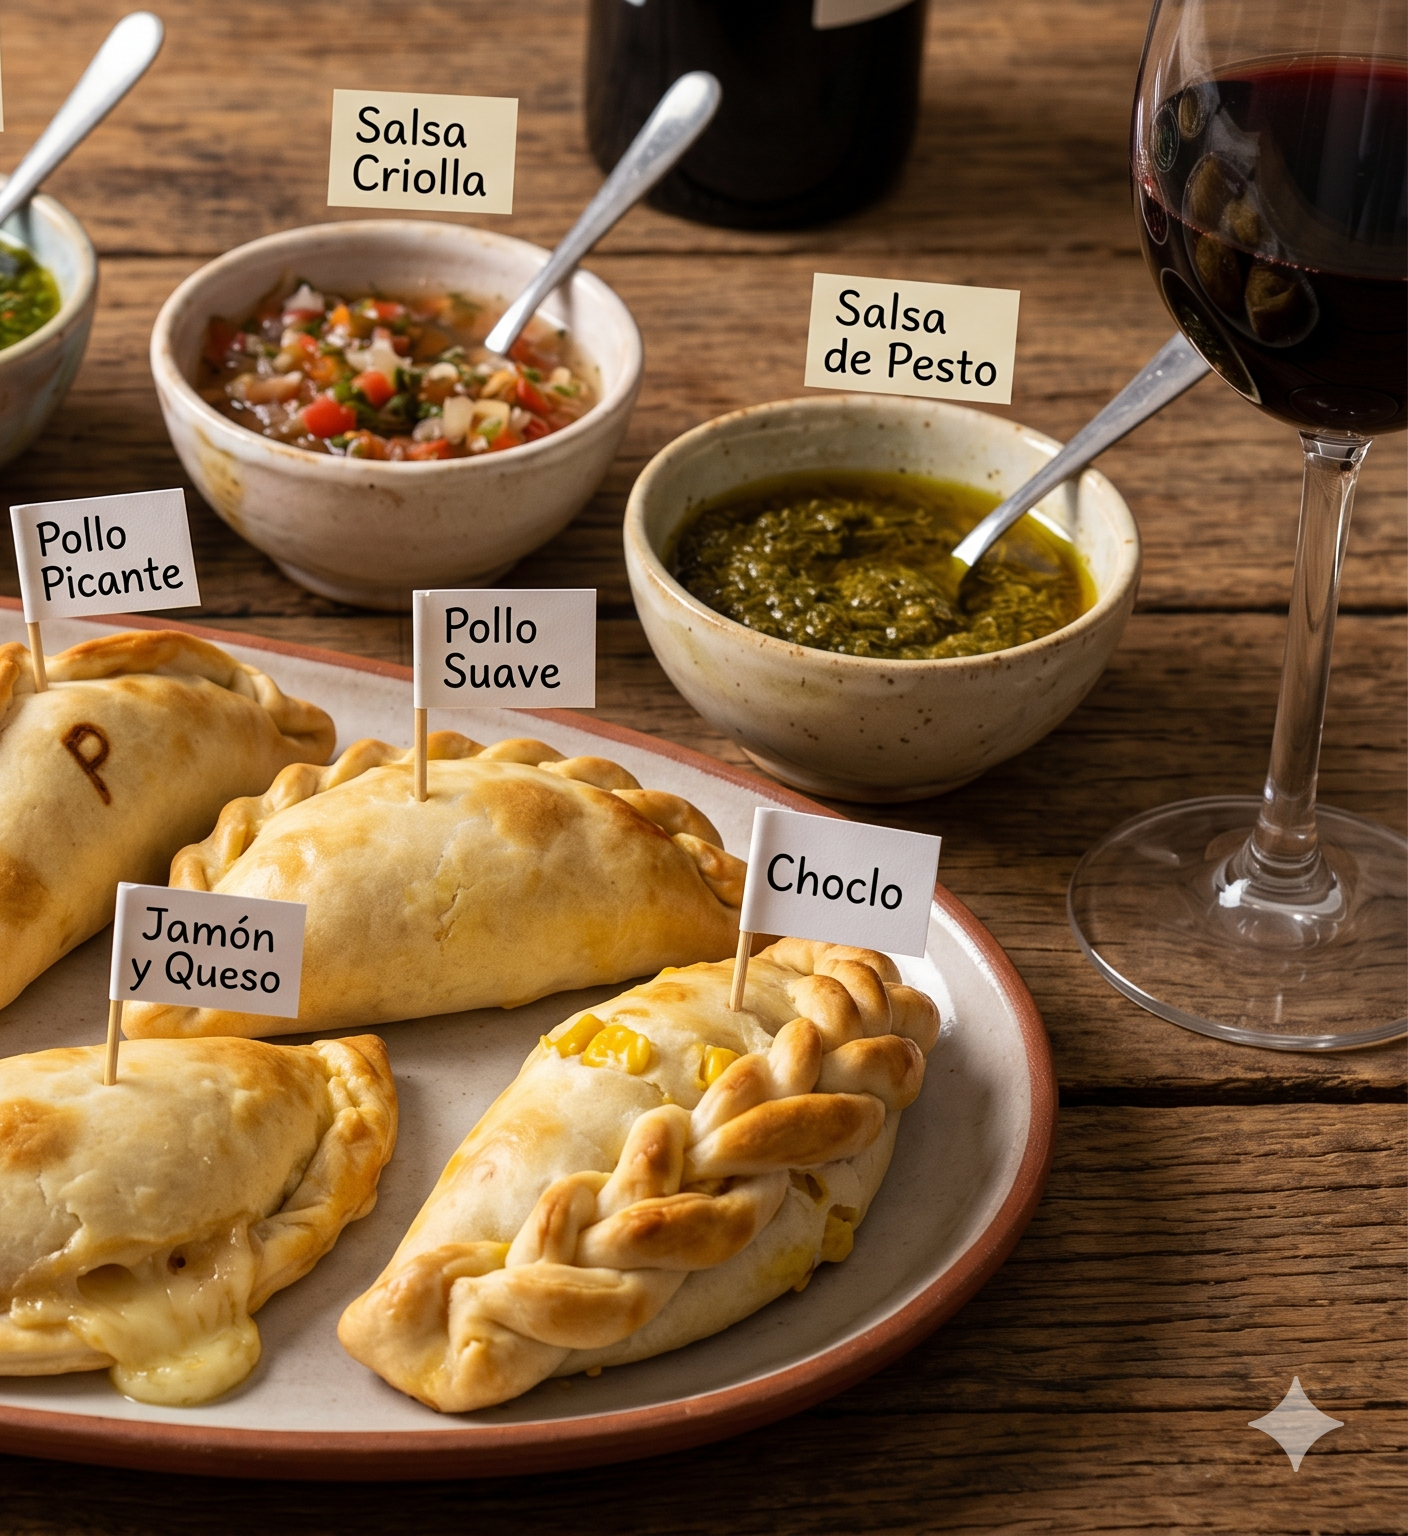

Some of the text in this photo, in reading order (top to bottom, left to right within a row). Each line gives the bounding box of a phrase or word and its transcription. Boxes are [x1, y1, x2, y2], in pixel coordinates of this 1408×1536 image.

[355, 106, 467, 149] Salsa
[353, 153, 487, 197] Criolla
[835, 289, 947, 335] Salsa
[824, 337, 997, 387] de Pesto
[35, 515, 127, 558] Pollo
[40, 557, 184, 602] Picante
[445, 605, 537, 645] Pollo
[443, 652, 561, 689] Suave
[60, 721, 113, 807] P
[766, 853, 903, 910] Choclo
[141, 906, 274, 953] Jamón
[129, 950, 281, 994] y Queso
